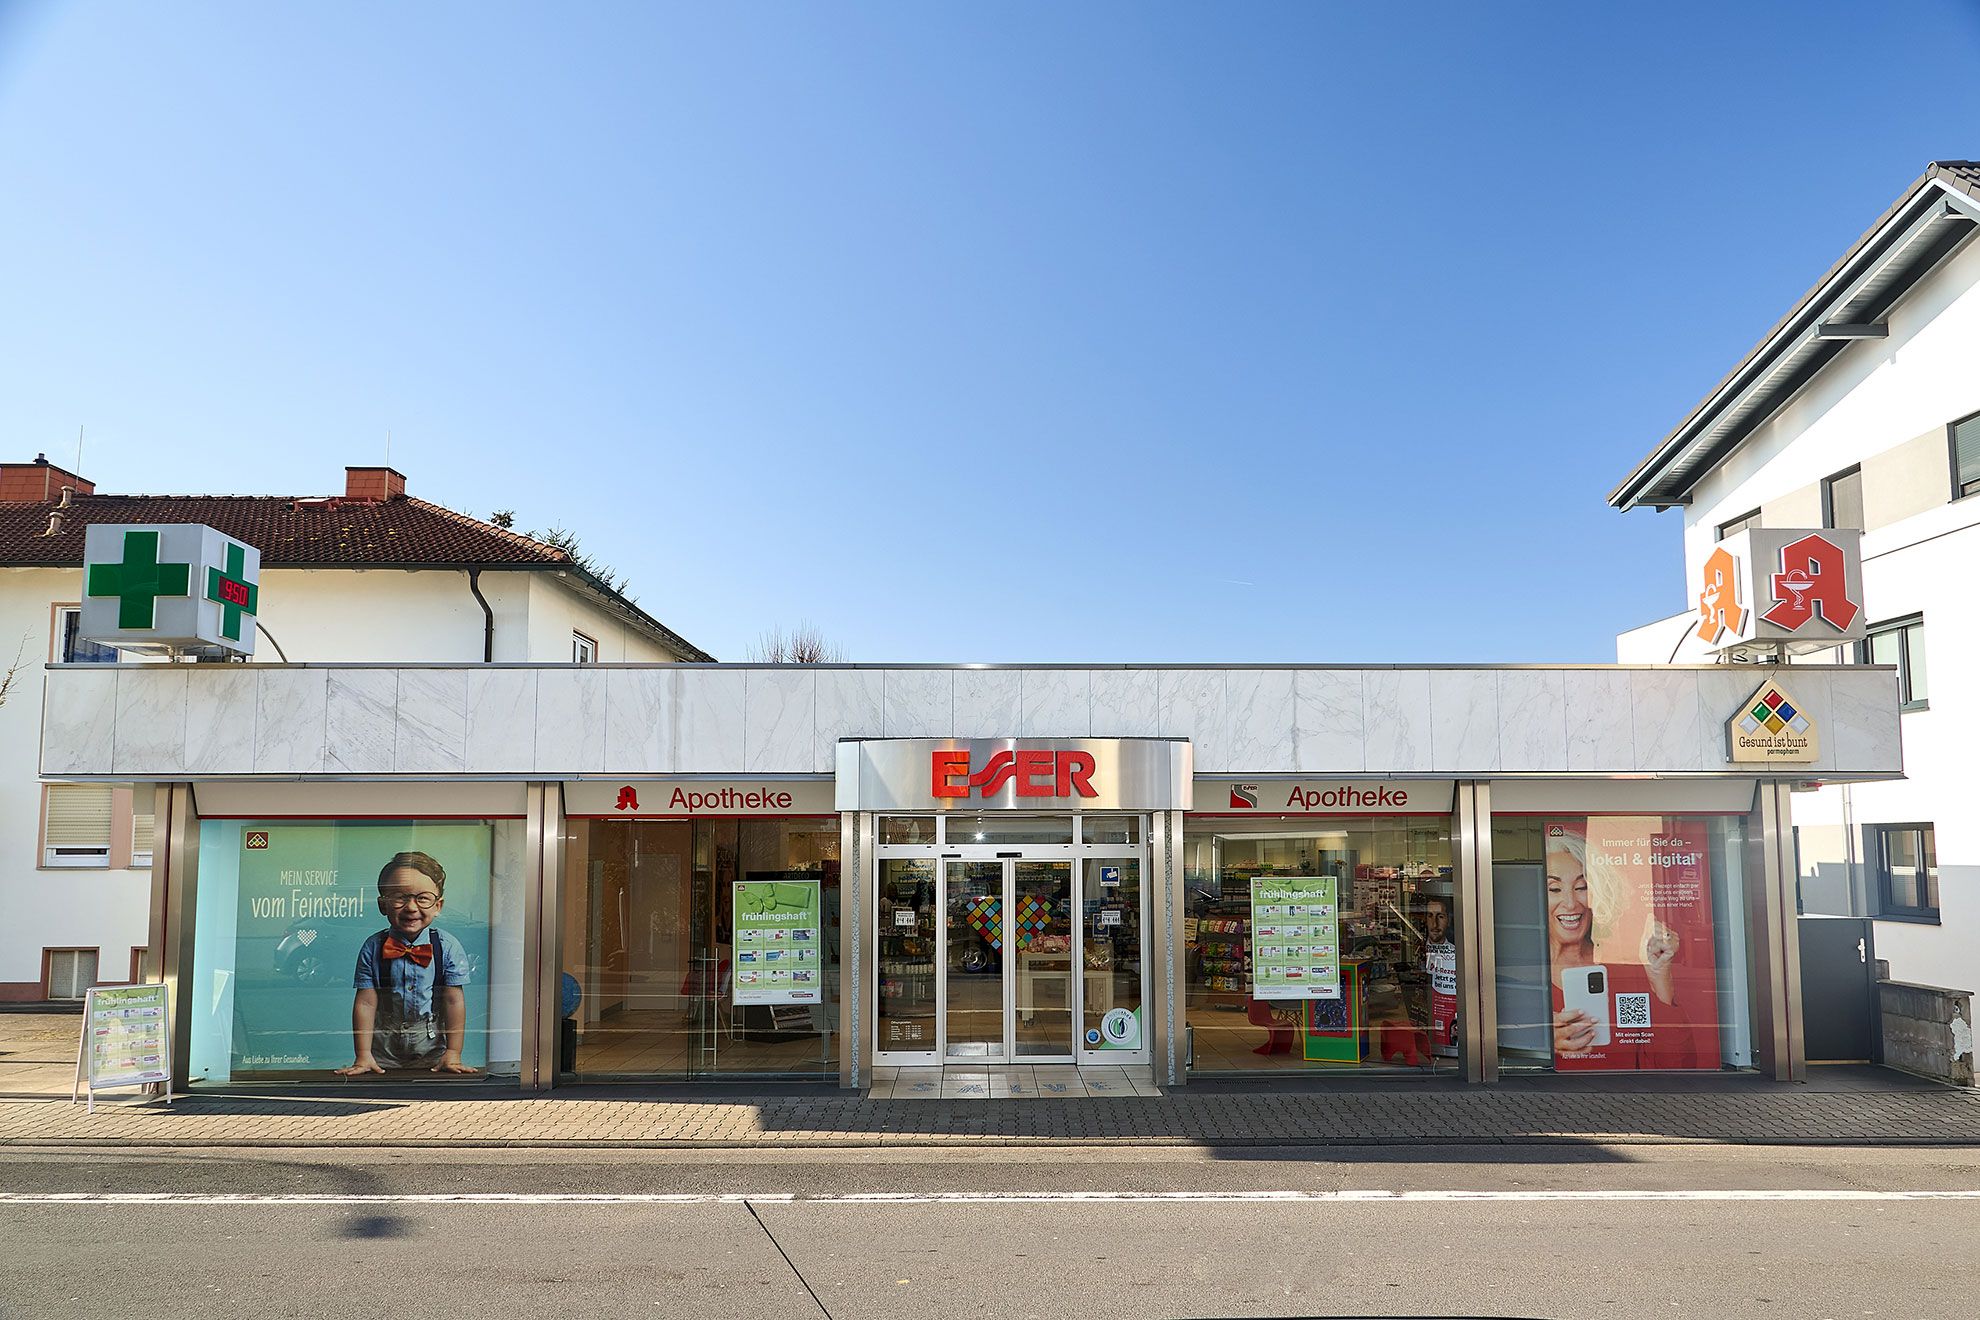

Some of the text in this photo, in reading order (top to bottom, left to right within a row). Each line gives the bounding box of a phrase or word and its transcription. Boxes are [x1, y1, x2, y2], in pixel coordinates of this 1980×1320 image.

[1739, 732, 1808, 748] Gesund ist bunt
[1767, 748, 1799, 756] parmapharm
[669, 787, 792, 813] Apotheke
[1286, 785, 1408, 811] Apotheke
[1602, 838, 1634, 847] Immer
[1636, 838, 1649, 847] für
[1652, 838, 1668, 847] Sie
[1671, 838, 1683, 847] da
[1591, 852, 1696, 868] lokal & digital
[280, 870, 339, 886] MEIN SERVICE
[251, 887, 364, 918] vom Feinsten!
[1259, 890, 1324, 900] frühlingshaft
[741, 911, 807, 922] frühlingshaft
